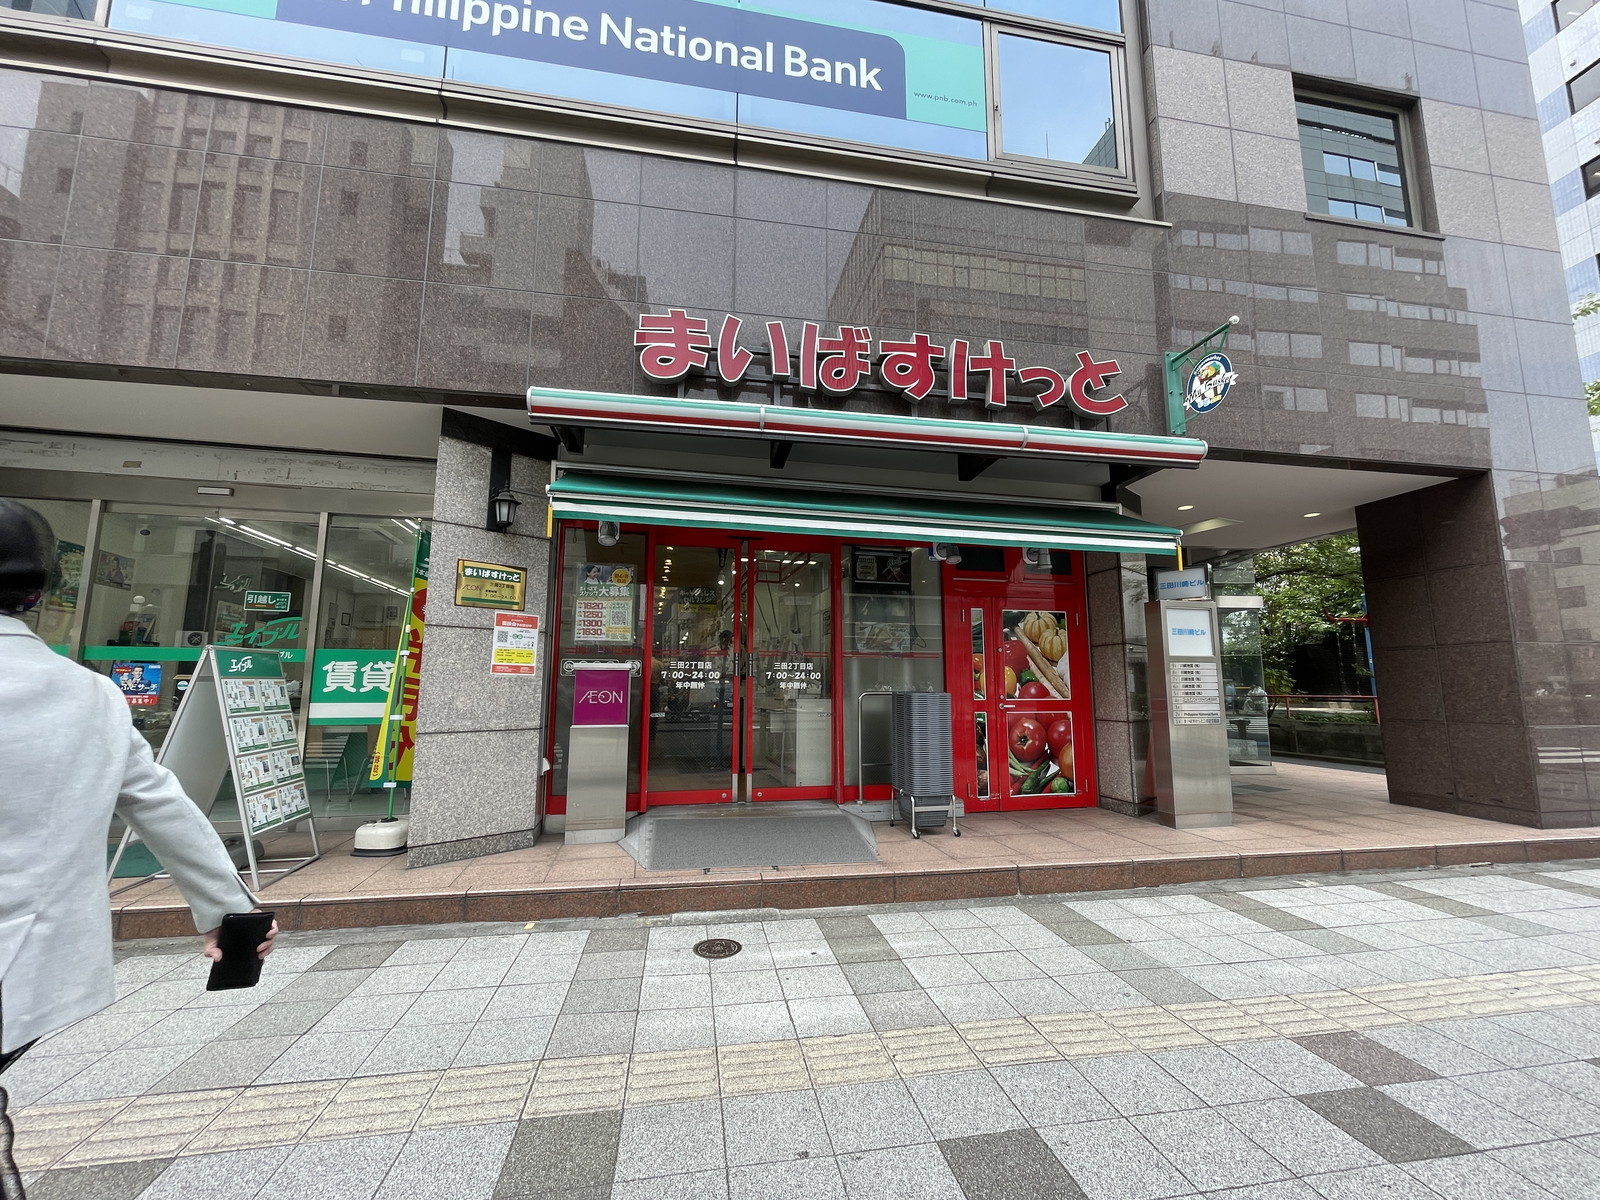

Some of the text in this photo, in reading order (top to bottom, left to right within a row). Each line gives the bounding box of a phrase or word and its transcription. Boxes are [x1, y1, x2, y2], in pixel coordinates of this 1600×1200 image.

[600, 12, 773, 73] National
[784, 45, 883, 91] Bank
[913, 91, 978, 107] www.pnb.com.ph
[634, 308, 1129, 416] まいばすけっと
[464, 567, 520, 582] まいばすけっと
[1160, 579, 1204, 589] 三田川崎ビル
[598, 586, 630, 597] 大募集
[246, 594, 276, 604] 引越し
[583, 611, 603, 619] 1250
[582, 620, 603, 628] 1300
[213, 616, 304, 647] エイブル
[228, 656, 253, 673] エイブル
[669, 661, 712, 669] 三田2丁目店
[773, 662, 814, 670] 三田2丁目店
[322, 660, 395, 693] 賃貸
[675, 681, 705, 690] 年中無休
[779, 681, 807, 690] 年中無休
